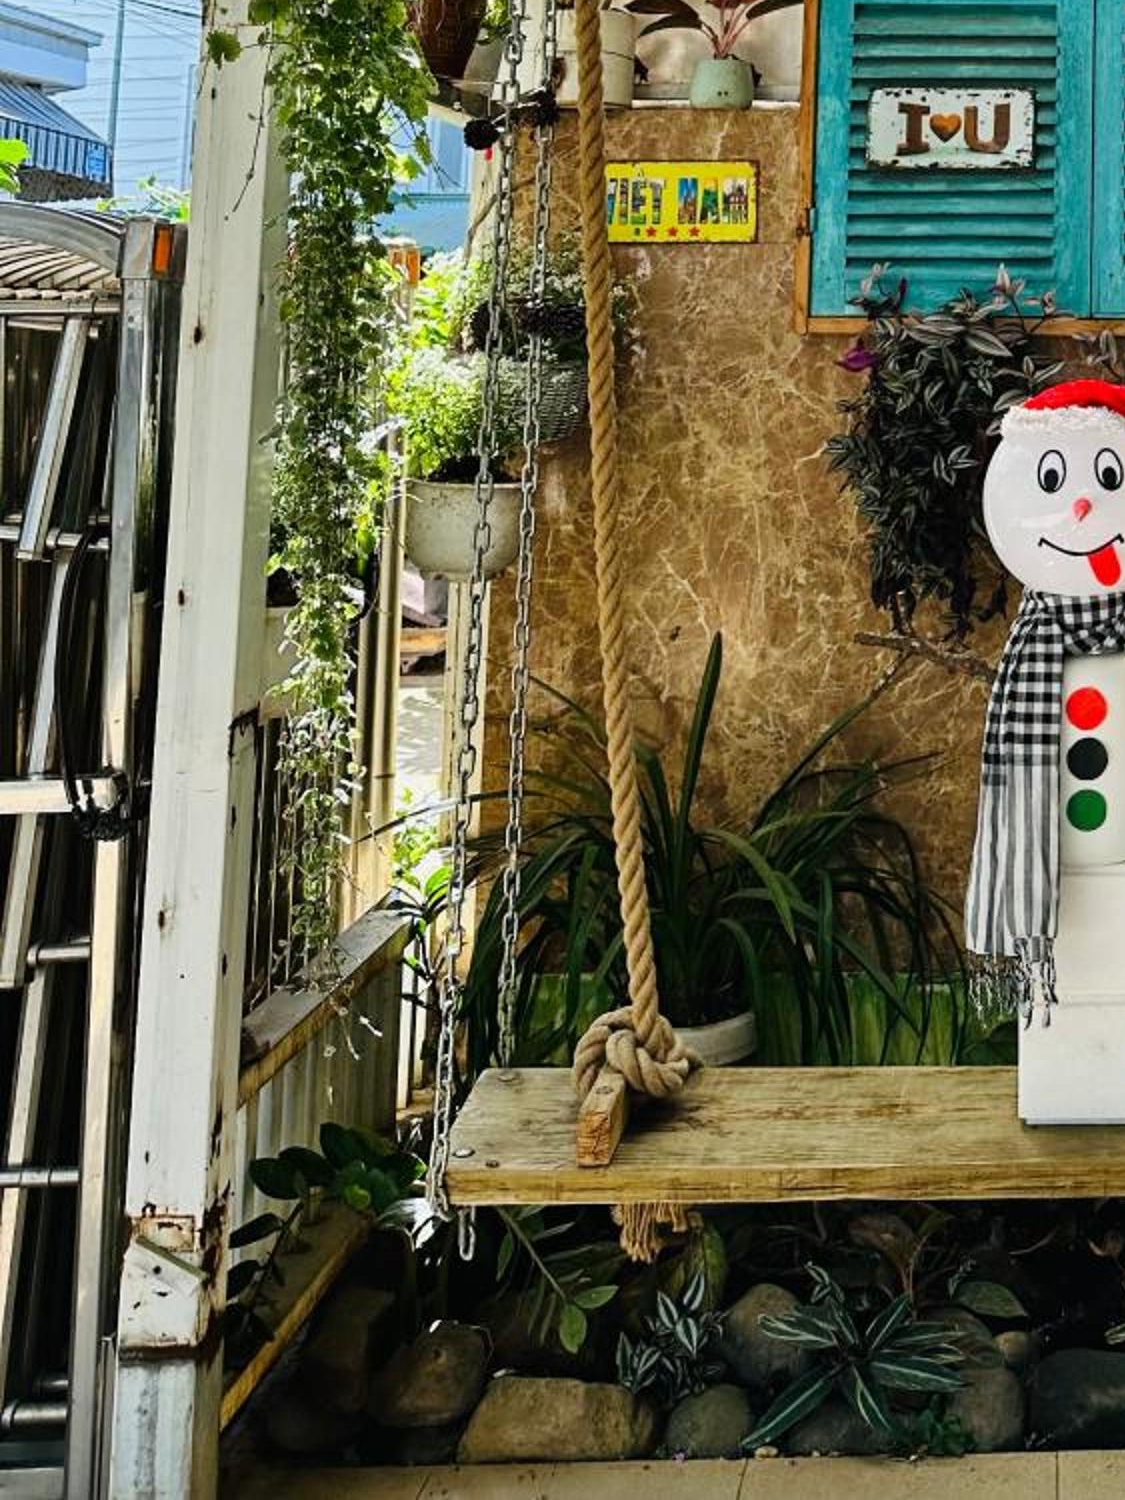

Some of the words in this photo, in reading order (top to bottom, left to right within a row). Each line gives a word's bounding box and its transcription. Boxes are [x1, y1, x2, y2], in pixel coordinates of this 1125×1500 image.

[896, 102, 930, 155] I
[964, 103, 1010, 154] U
[678, 178, 748, 224] NAM
